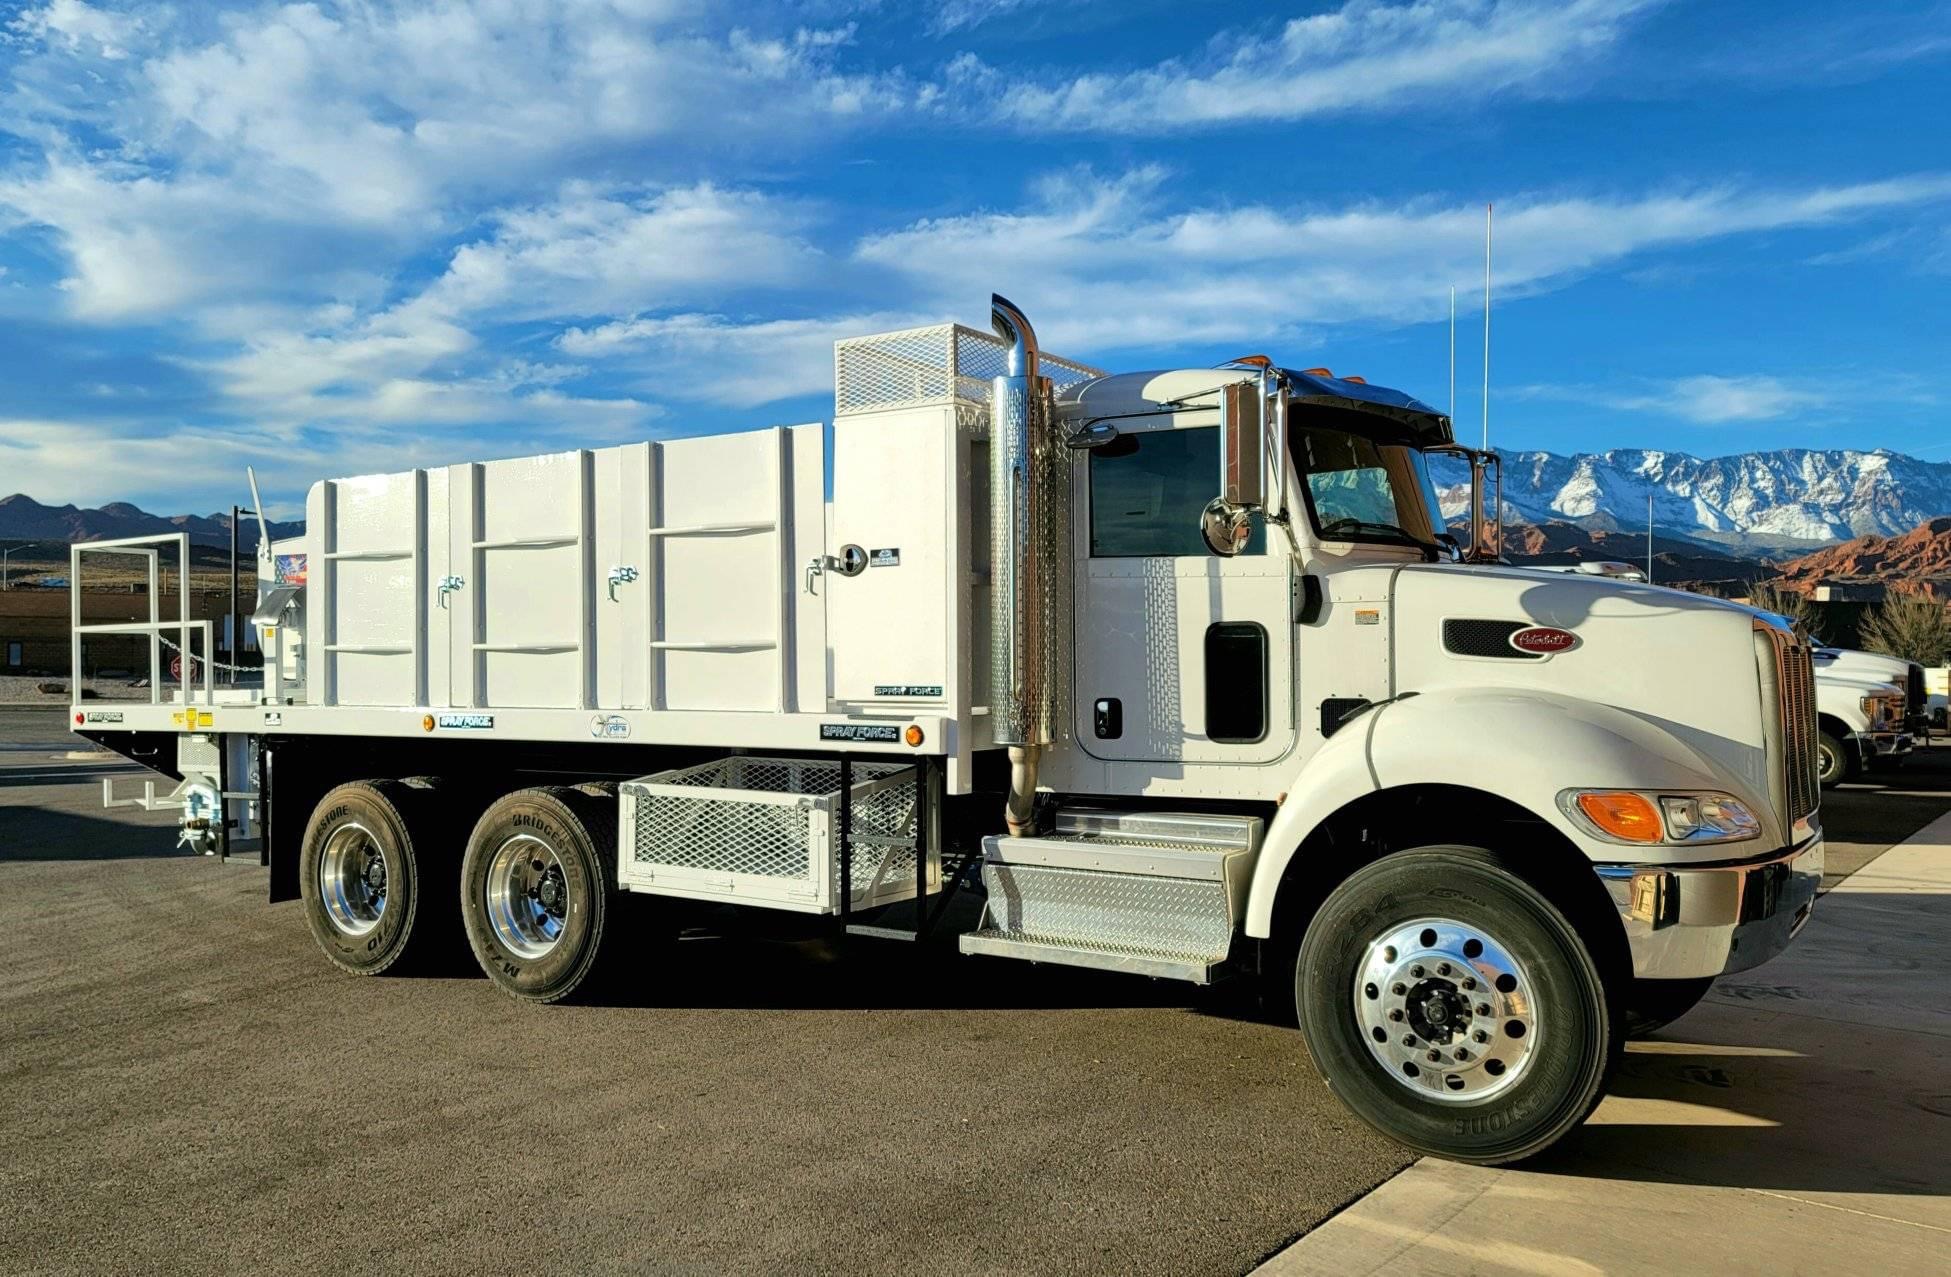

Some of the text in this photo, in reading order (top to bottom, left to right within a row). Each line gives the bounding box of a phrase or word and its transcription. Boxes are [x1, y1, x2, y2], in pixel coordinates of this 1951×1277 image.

[173, 663, 195, 672] SP
[909, 687, 941, 696] FORCE
[512, 814, 580, 891] BRIDGESTONE
